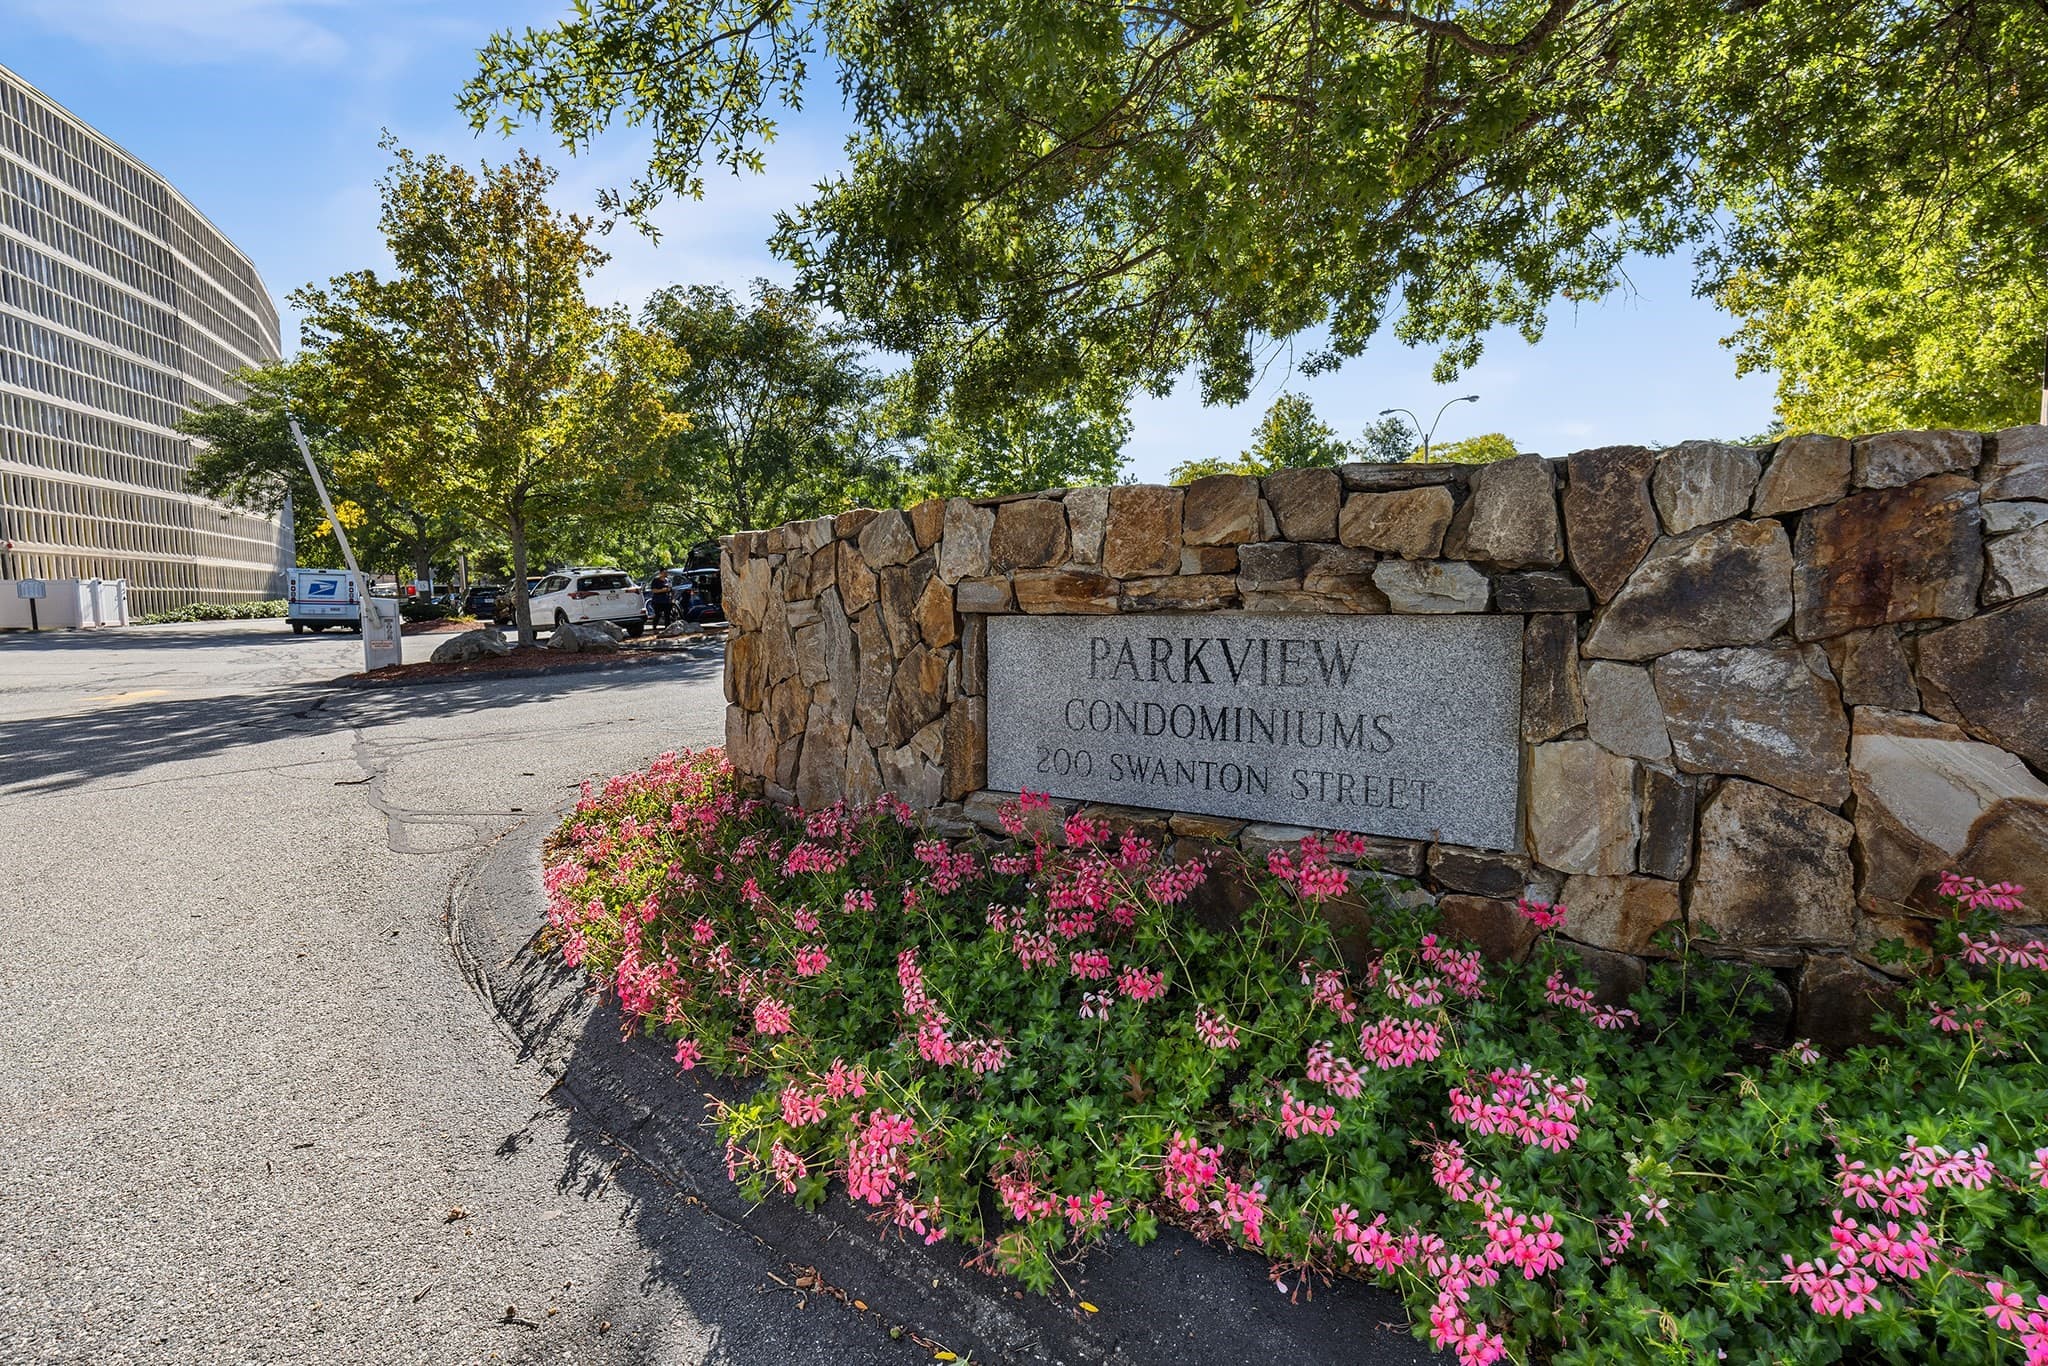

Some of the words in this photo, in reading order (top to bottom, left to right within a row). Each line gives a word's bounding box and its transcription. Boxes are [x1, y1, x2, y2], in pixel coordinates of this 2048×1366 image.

[1088, 636, 1364, 688] PARKVIEW
[1065, 699, 1395, 754] CONDOMINIUMS
[1037, 747, 1092, 777] 200
[1109, 753, 1269, 796] SWANTON
[1290, 768, 1435, 813] STREET
